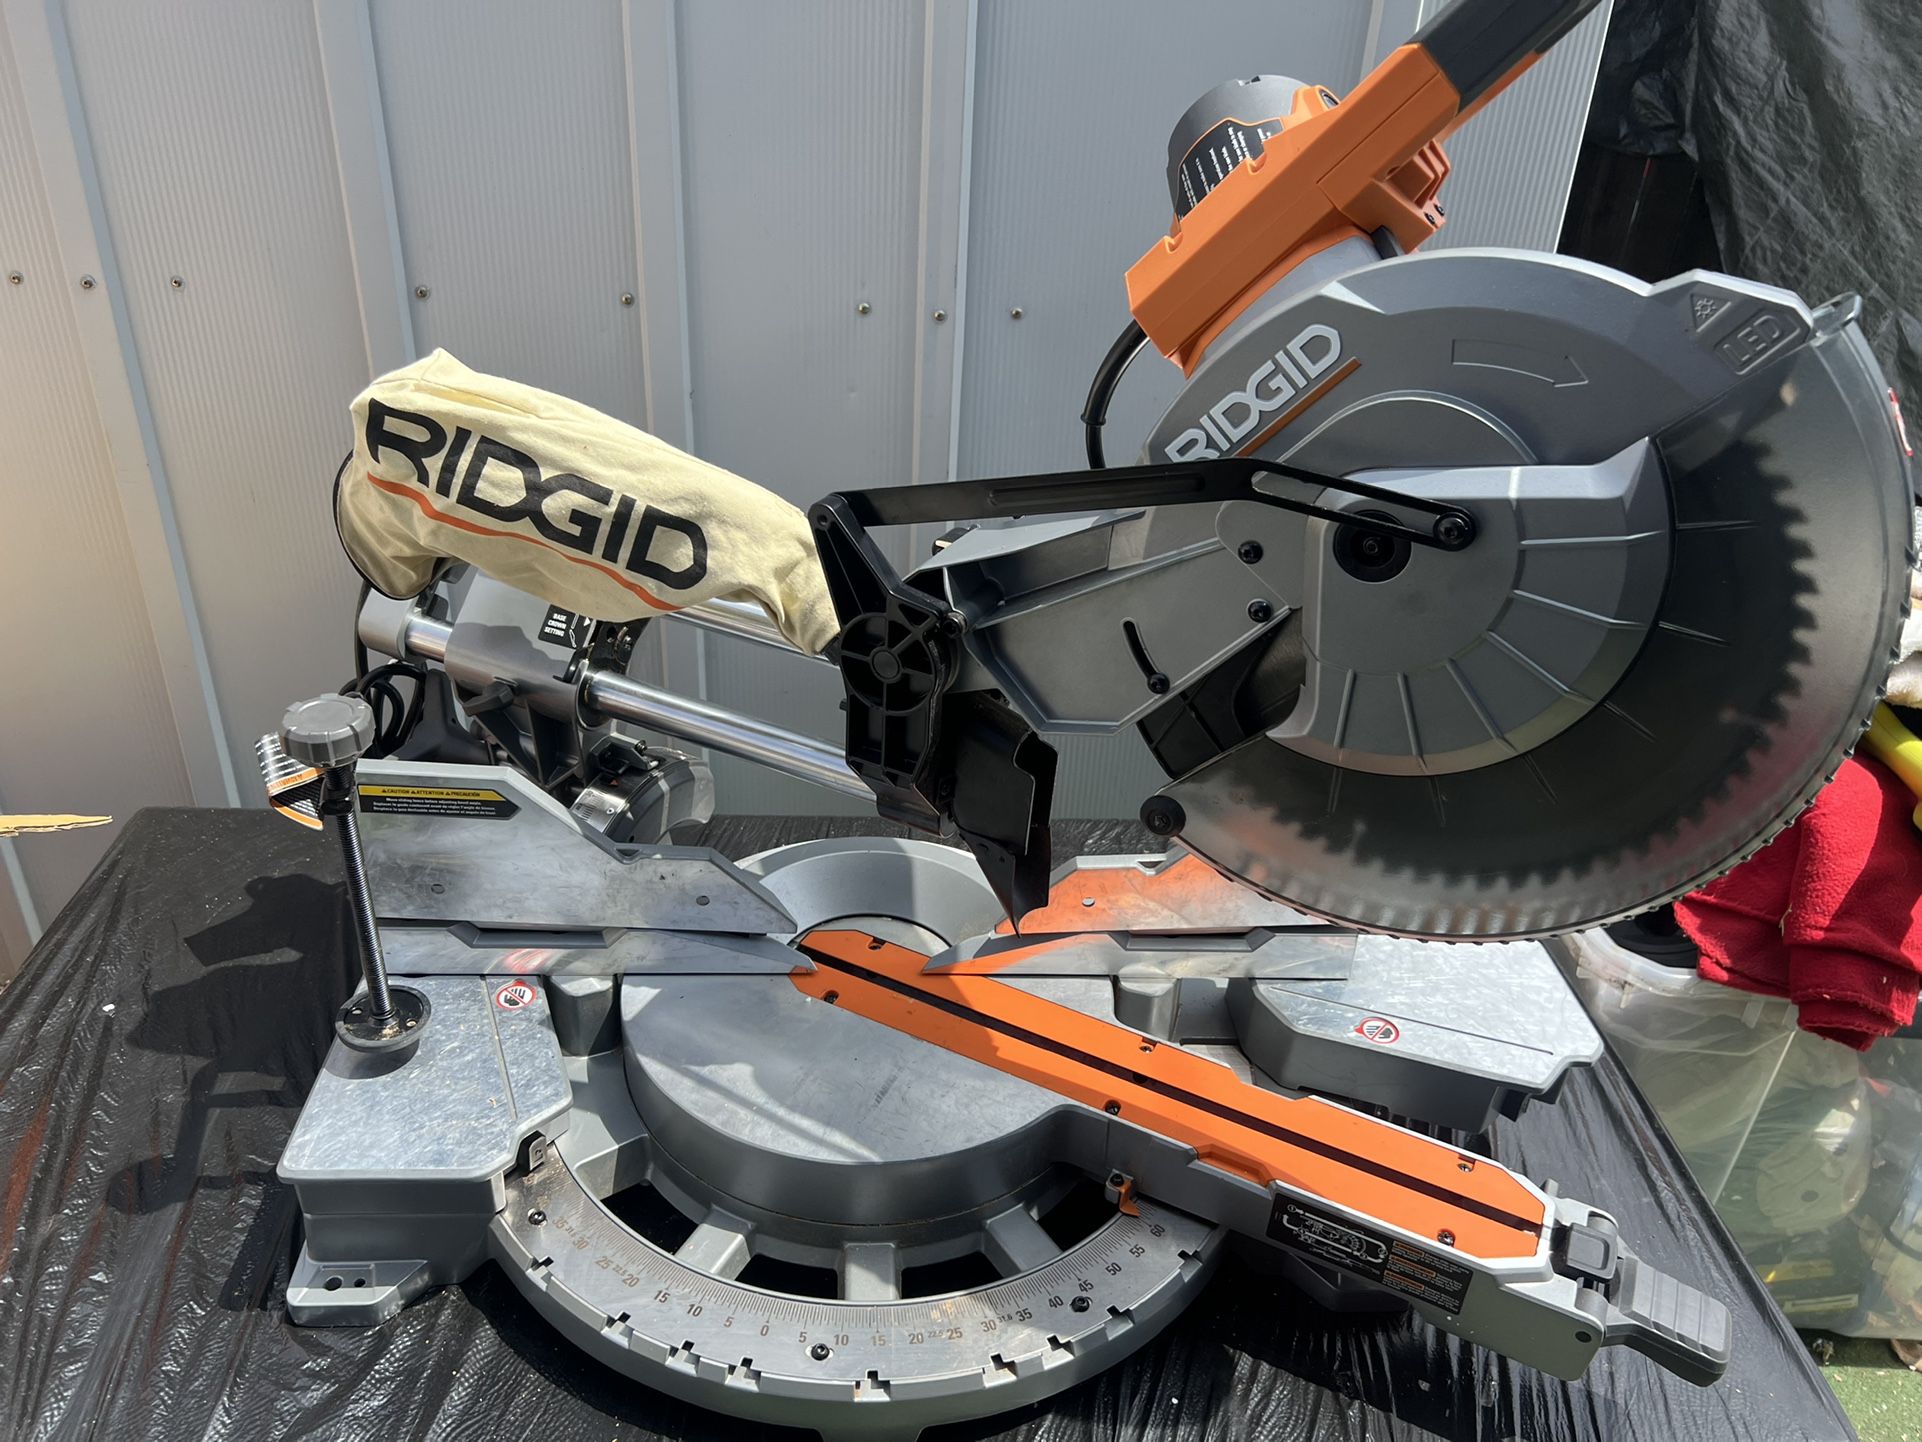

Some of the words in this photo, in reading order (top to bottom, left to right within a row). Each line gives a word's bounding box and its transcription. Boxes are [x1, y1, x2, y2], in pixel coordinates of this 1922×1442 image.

[1722, 314, 1780, 362] LED
[1164, 324, 1342, 463] RIDGID
[366, 398, 708, 589] RIDGID
[544, 626, 565, 637] SETTING
[547, 619, 567, 630] CROWN
[553, 613, 567, 622] BASE
[573, 1235, 589, 1250] 30
[595, 1256, 614, 1270] 25
[622, 1273, 641, 1288] 20
[654, 1290, 671, 1304] 15
[687, 1303, 703, 1317] 10
[723, 1316, 735, 1328] 5
[760, 1324, 770, 1336] 0
[798, 1331, 807, 1343] 5
[833, 1334, 849, 1346] 10
[871, 1335, 887, 1347] 15
[908, 1332, 925, 1345] 20
[946, 1327, 963, 1340] 25
[980, 1319, 997, 1333] 30
[1015, 1307, 1033, 1322] 35
[1047, 1295, 1064, 1309] 40
[1078, 1279, 1095, 1293] 45
[1105, 1262, 1122, 1276] 50
[1129, 1244, 1146, 1258] 55
[1150, 1223, 1166, 1238] 60
